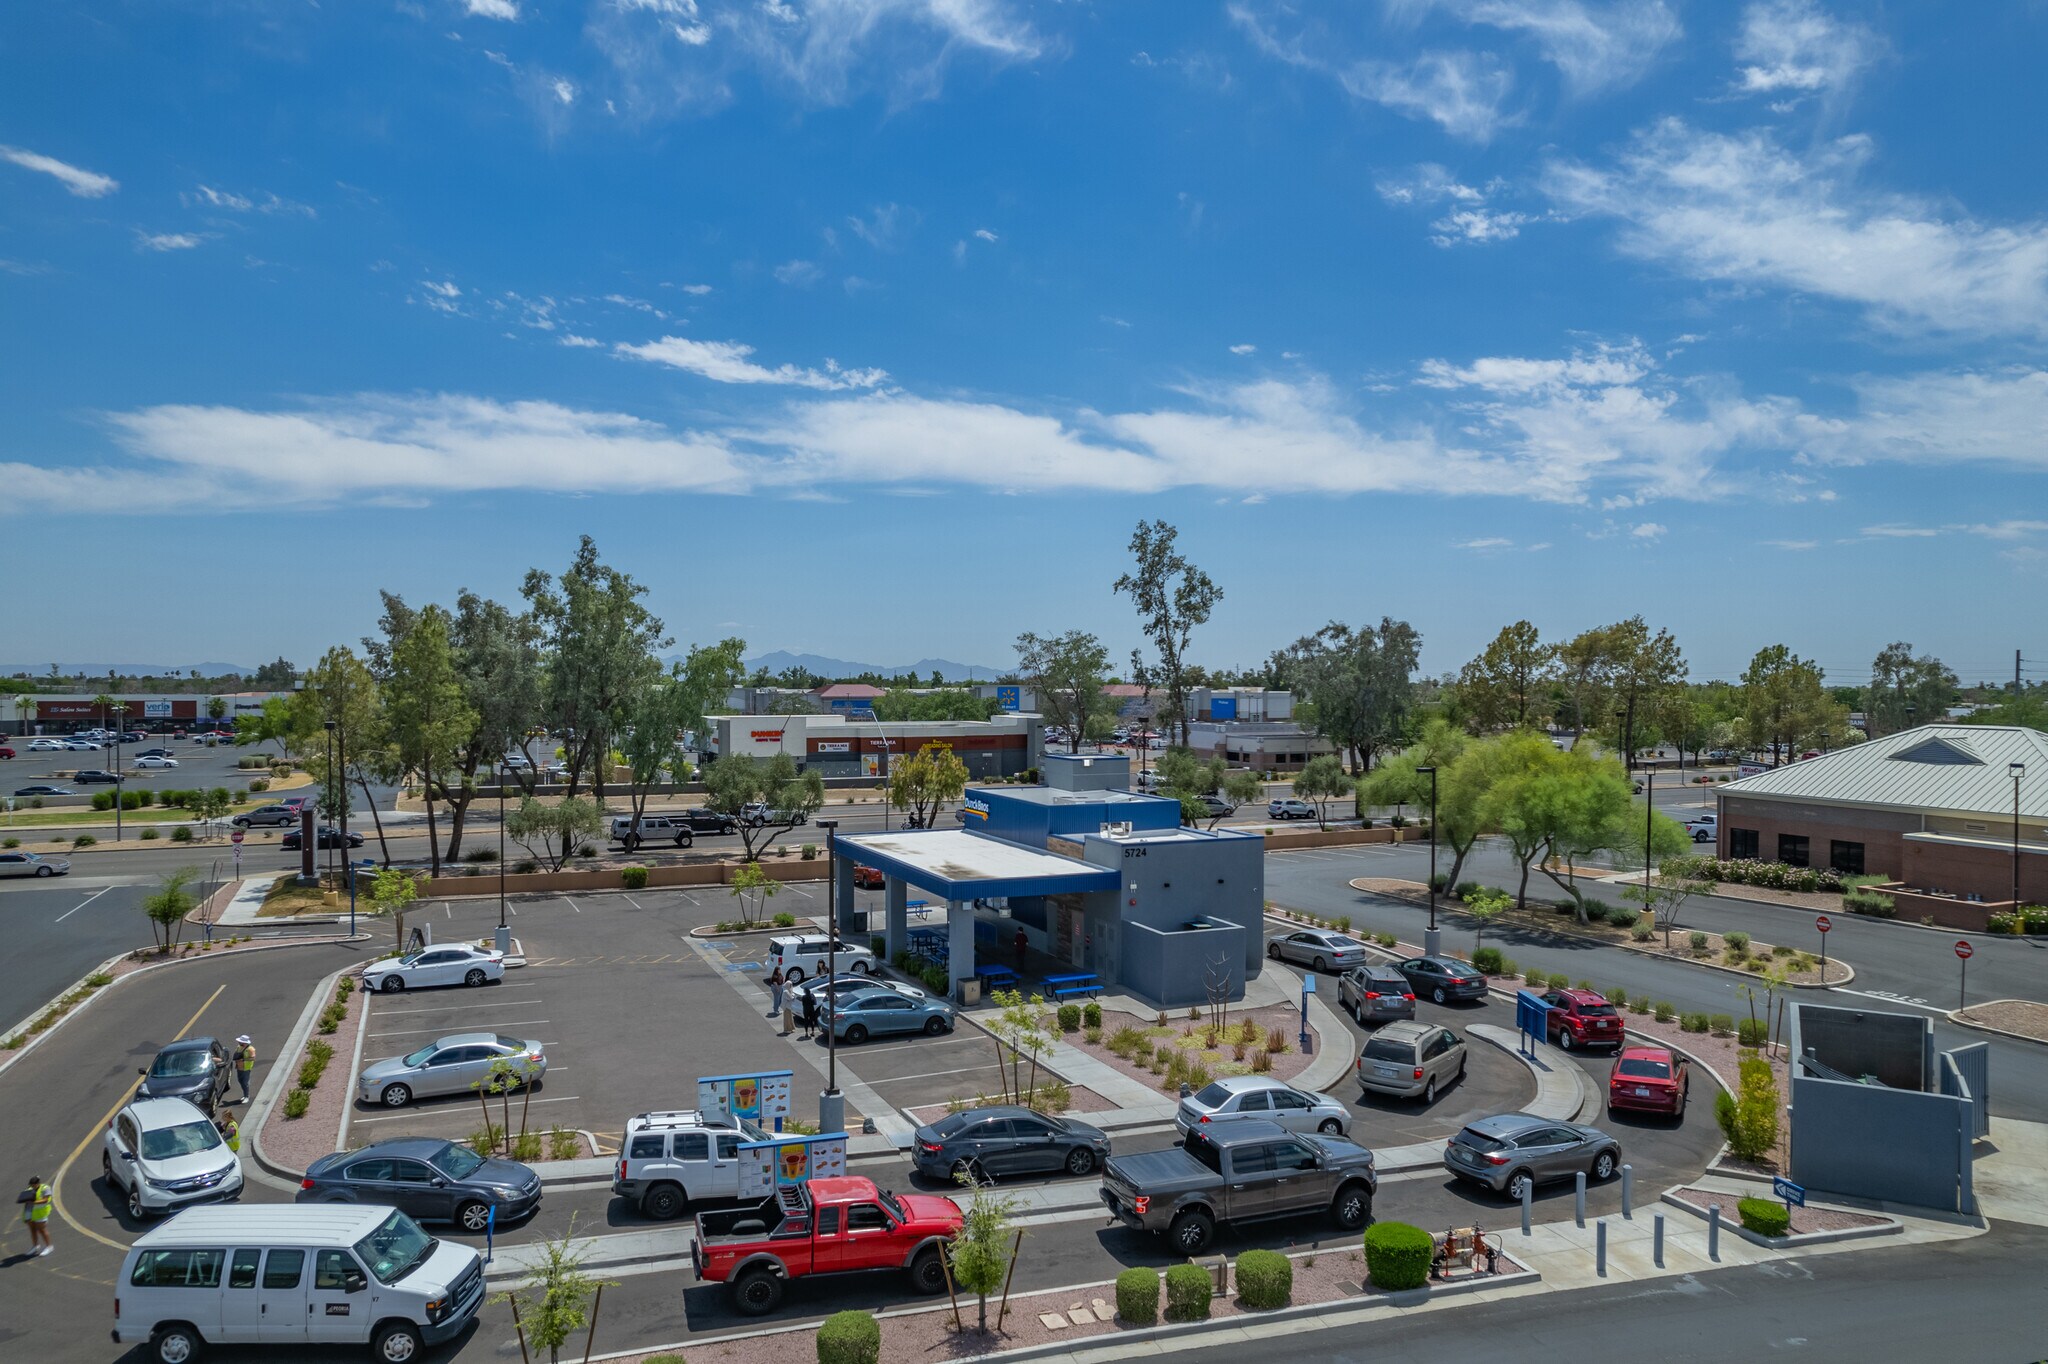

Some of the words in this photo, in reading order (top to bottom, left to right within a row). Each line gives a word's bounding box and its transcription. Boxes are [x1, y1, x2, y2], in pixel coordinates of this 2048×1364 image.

[1124, 847, 1147, 858] 5724
[1865, 990, 1928, 1004] STOP
[1787, 1186, 1801, 1197] DRIVE
[1787, 1192, 1800, 1202] THRU
